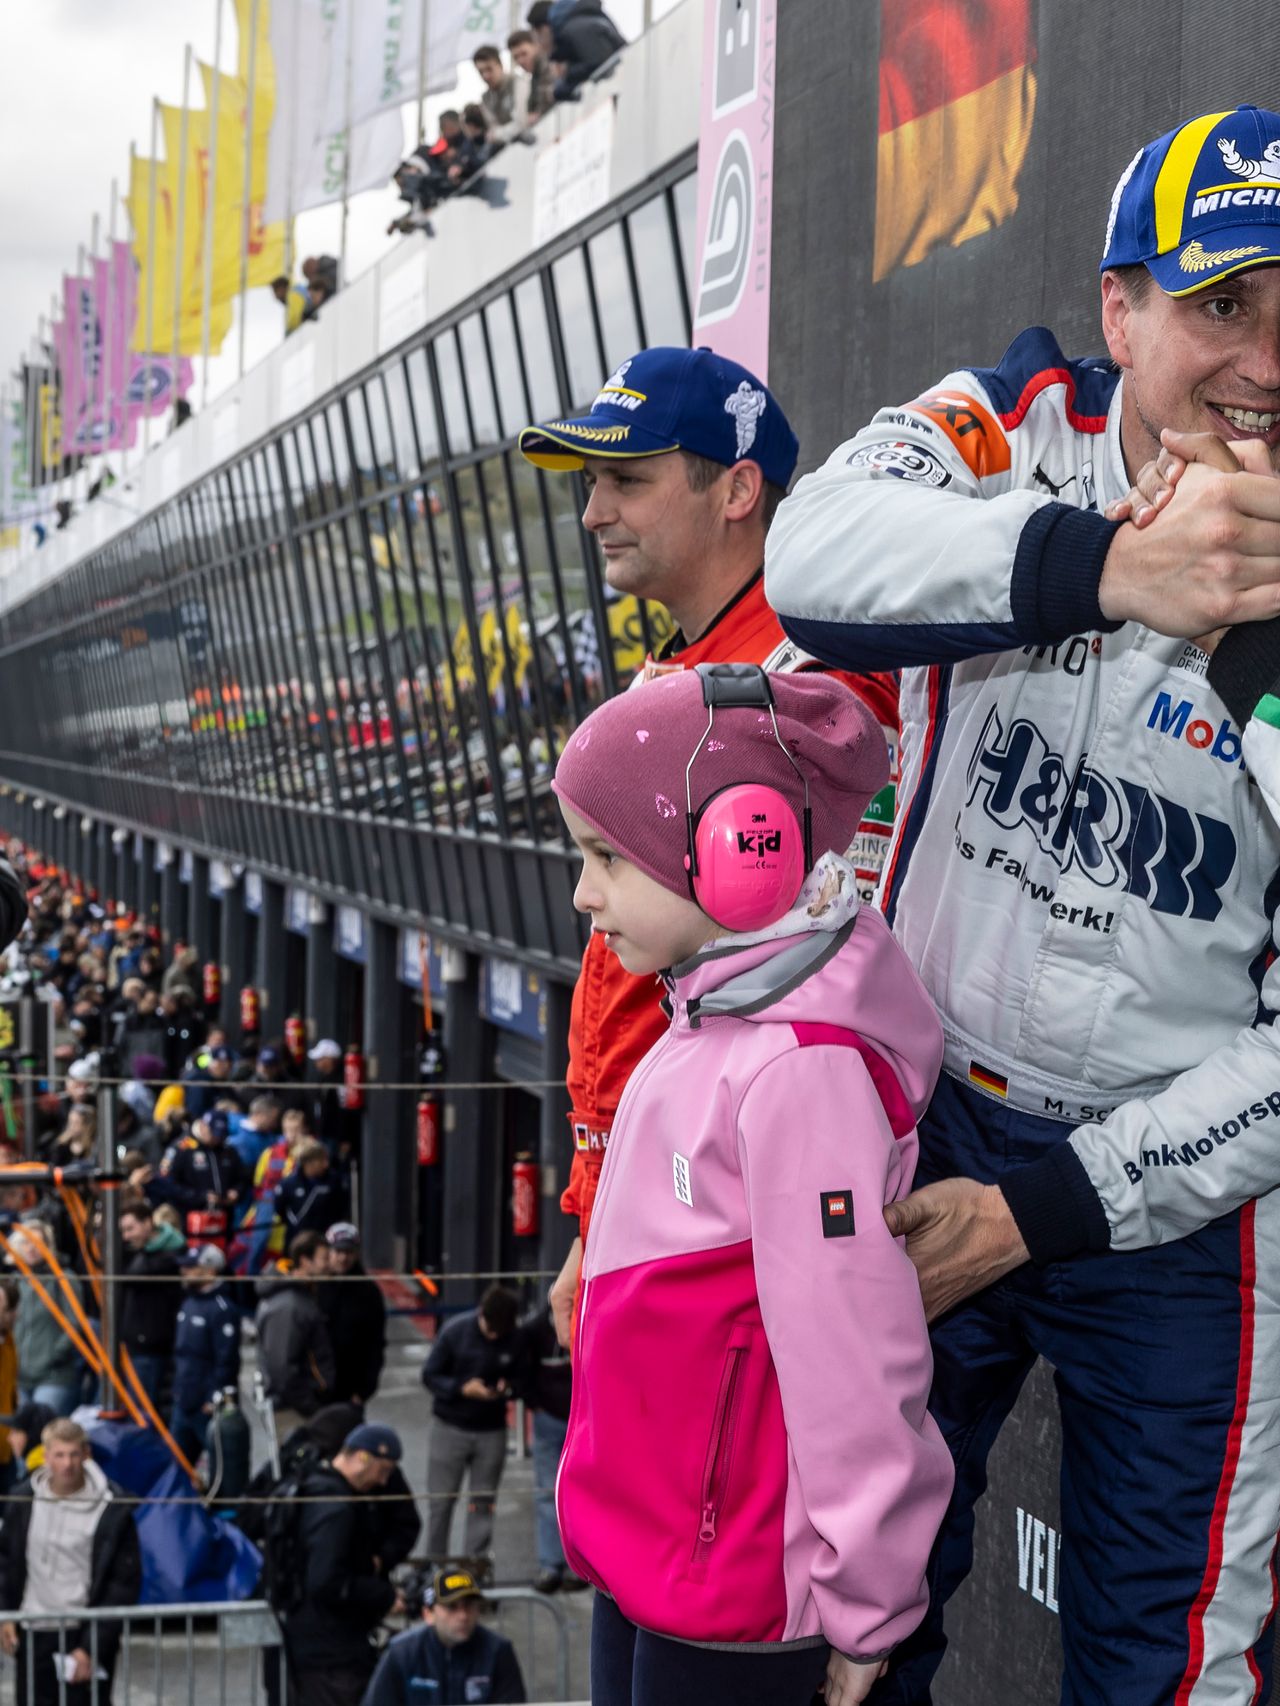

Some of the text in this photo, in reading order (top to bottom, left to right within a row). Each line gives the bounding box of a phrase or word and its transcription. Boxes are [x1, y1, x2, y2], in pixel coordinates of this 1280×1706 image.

[1146, 691, 1247, 772] Mob
[736, 830, 782, 858] kid
[1043, 1096, 1072, 1117] M.
[1016, 1506, 1062, 1614] VEL
